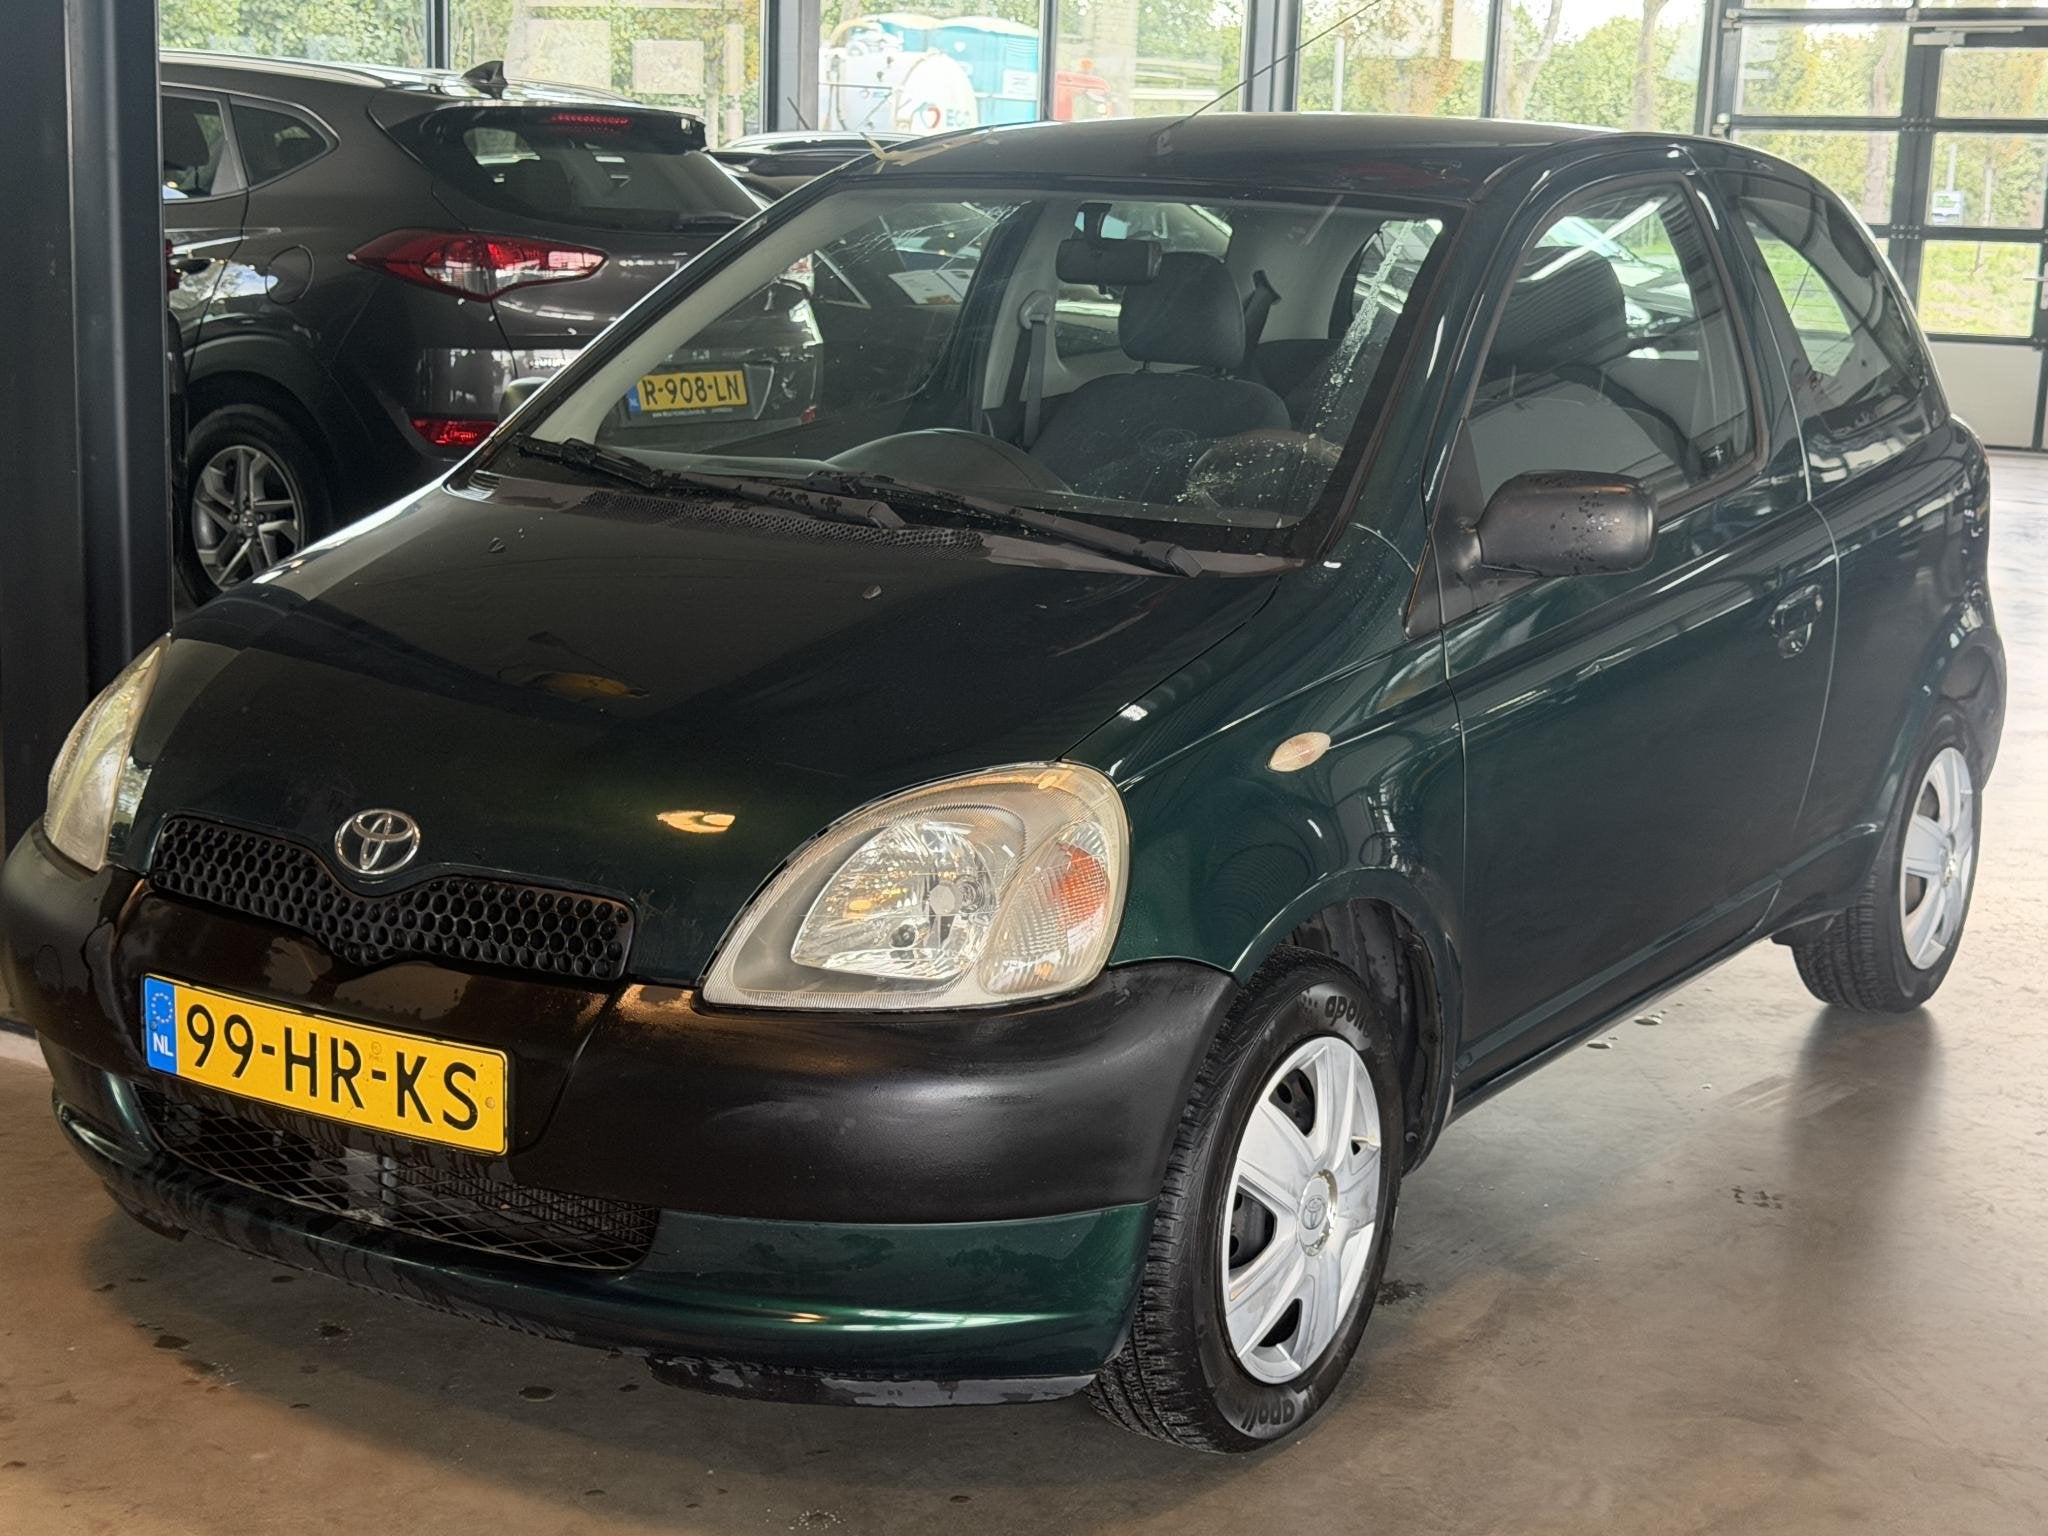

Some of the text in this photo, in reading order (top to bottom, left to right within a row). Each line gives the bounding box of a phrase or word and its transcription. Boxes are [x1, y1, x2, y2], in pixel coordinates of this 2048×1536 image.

[643, 375, 740, 405] R-908-LN
[153, 1032, 174, 1057] NL
[187, 1003, 478, 1131] 99-HR-KS
